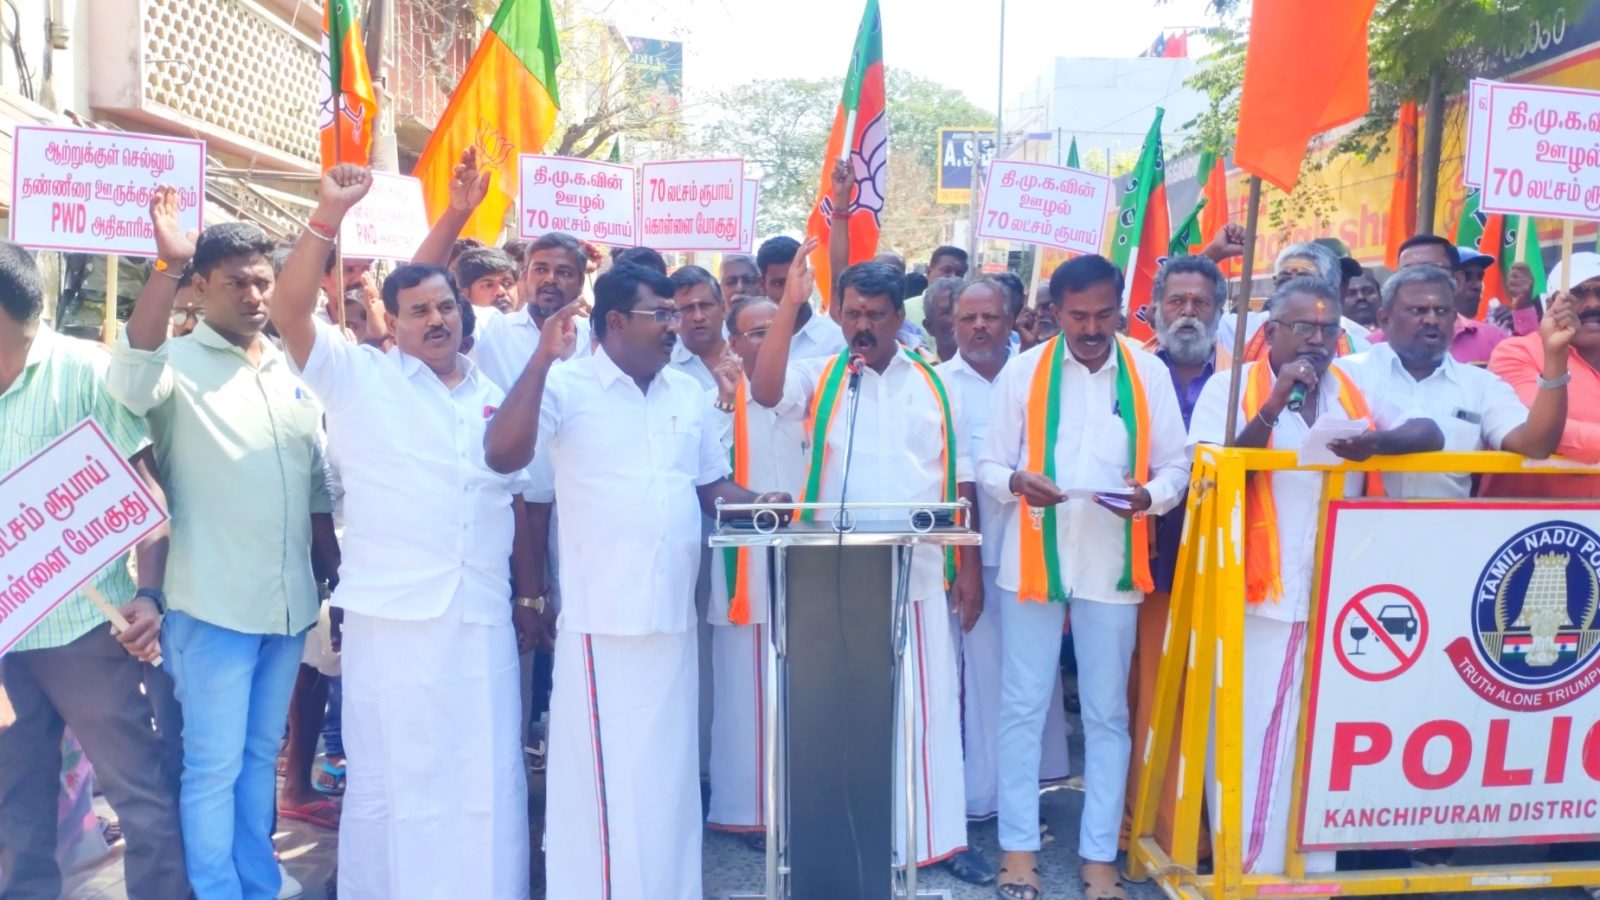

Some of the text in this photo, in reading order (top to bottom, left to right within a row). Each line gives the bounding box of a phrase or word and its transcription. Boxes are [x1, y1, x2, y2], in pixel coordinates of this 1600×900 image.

[45, 140, 174, 177] ஆற்றுக்குள் செல்லும்
[22, 173, 92, 202] தண்ணீரை
[534, 165, 623, 191] தி.மு.க.வின்
[650, 178, 734, 208] 70 லட்சம் ரூபாய்
[1000, 169, 1096, 200] தி.மு.க.வின்
[1493, 167, 1524, 197] 70
[1527, 177, 1581, 202] லட்சம்
[51, 202, 87, 234] PWD
[555, 190, 605, 214] ஊழல்
[1019, 193, 1072, 217] ஊழல்
[526, 209, 632, 239] 70 லட்சம் ரூபாய்
[645, 213, 693, 235] கொள்ளை
[695, 211, 738, 243] போகுது
[986, 210, 1097, 246] 70 லட்சம் ரூபாய்
[43, 454, 110, 522] ரூபாய்
[62, 491, 150, 555] போகுது
[1480, 548, 1524, 603] TAMIL
[1524, 529, 1580, 551] NADU
[1458, 657, 1496, 696] TRUTH
[1496, 688, 1542, 706] ALONE
[1324, 799, 1600, 829] KANCHIPURAM DISTRIC
